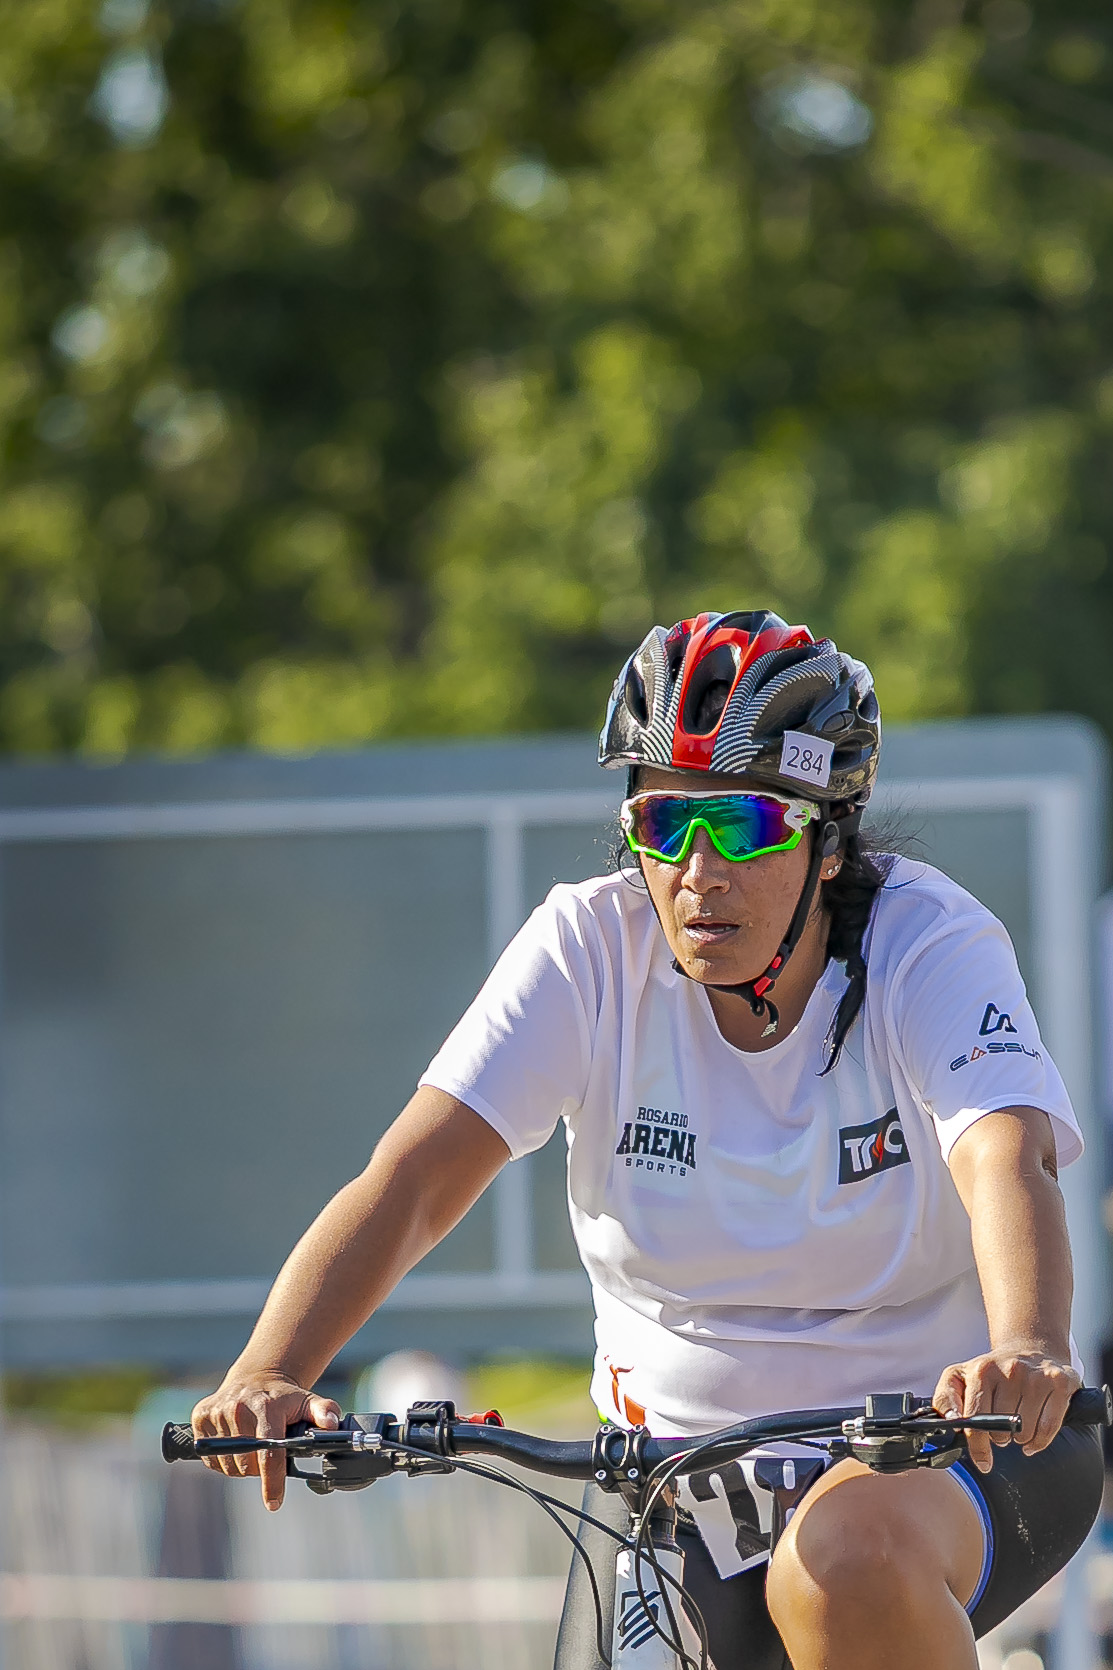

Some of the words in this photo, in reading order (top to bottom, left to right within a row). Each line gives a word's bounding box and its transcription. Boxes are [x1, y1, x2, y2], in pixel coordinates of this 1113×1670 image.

[786, 745, 824, 776] 284
[636, 1106, 689, 1129] ROSARIO
[615, 1122, 697, 1170] ARENA
[625, 1157, 687, 1177] SPORTS
